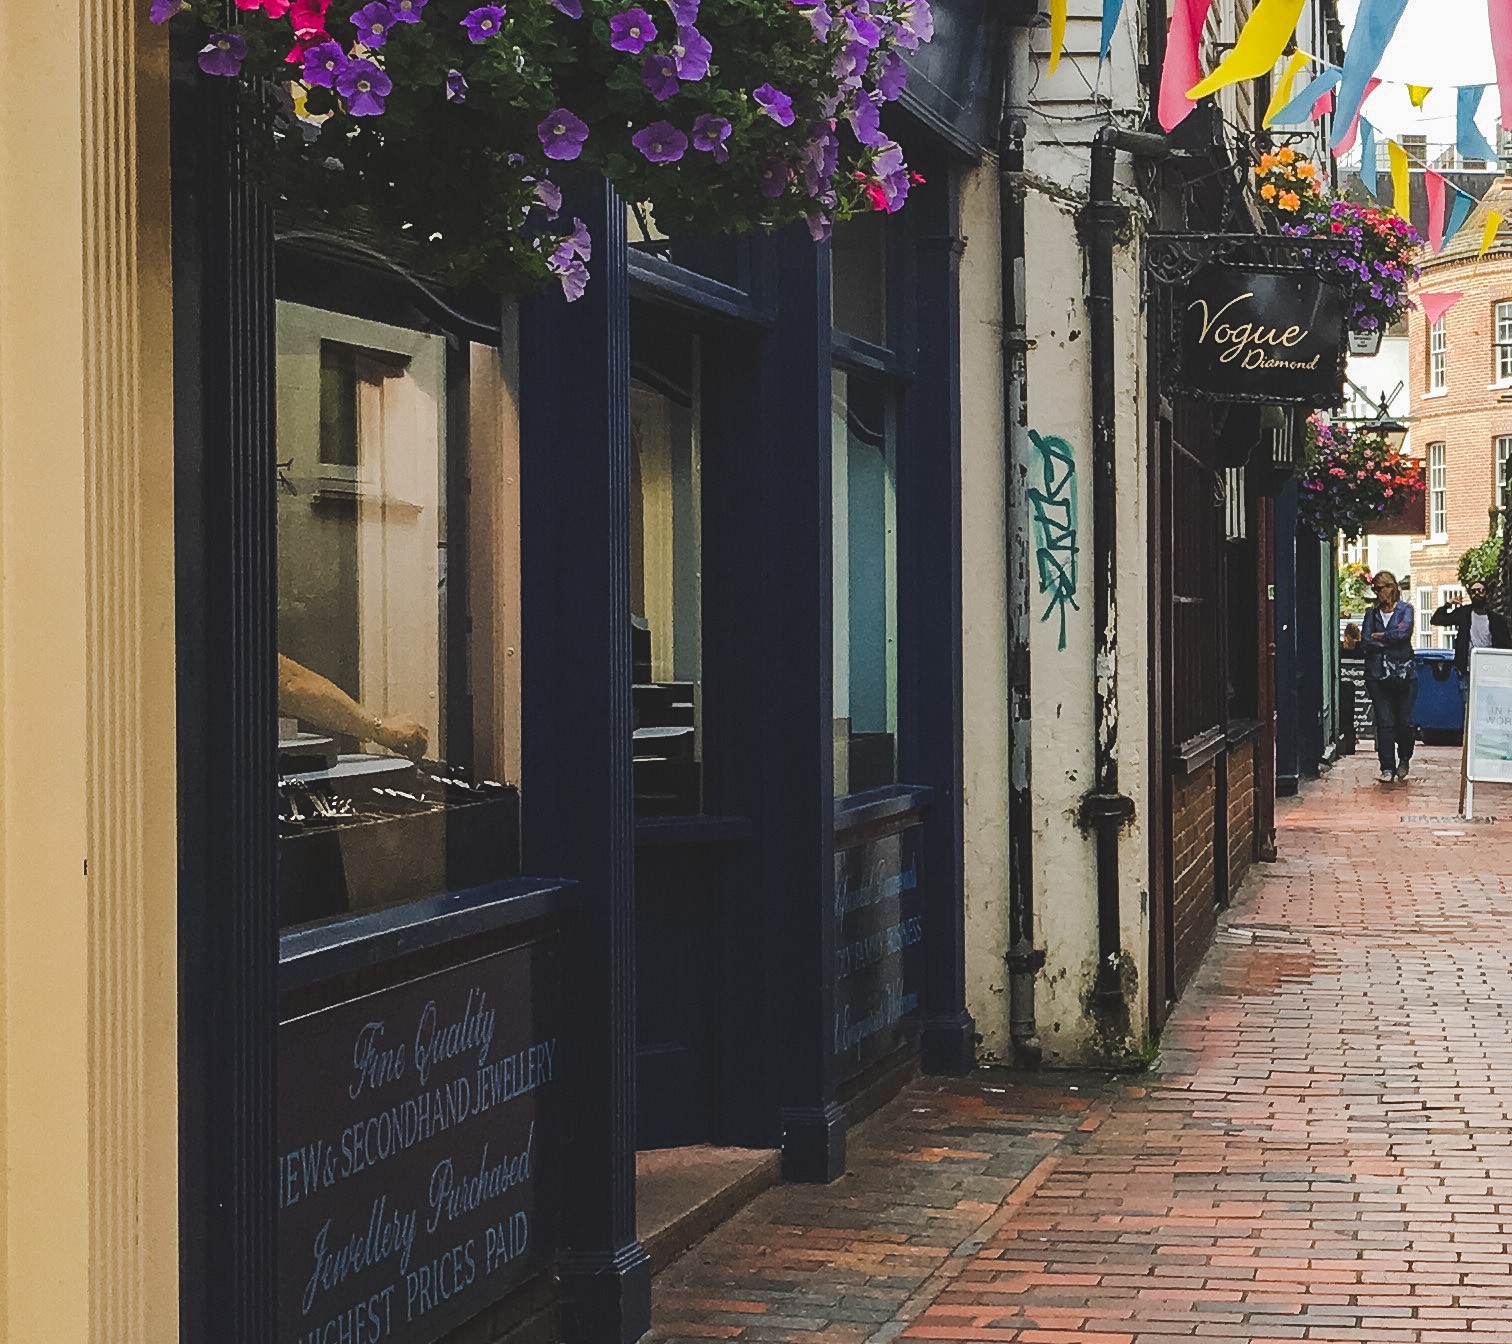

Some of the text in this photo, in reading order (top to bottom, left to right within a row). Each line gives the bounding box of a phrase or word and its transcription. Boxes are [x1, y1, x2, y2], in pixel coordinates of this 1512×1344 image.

[1187, 292, 1308, 363] Vogue
[1241, 349, 1320, 370] Diamond
[349, 985, 497, 1100] Fine Quality
[322, 1146, 338, 1187] &
[341, 1077, 470, 1178] SECONDHAND
[471, 1038, 557, 1116] JEWELLERY
[302, 1121, 535, 1316] Jewellery Purchased
[406, 1239, 476, 1322] PRICES
[486, 1210, 529, 1275] PAID
